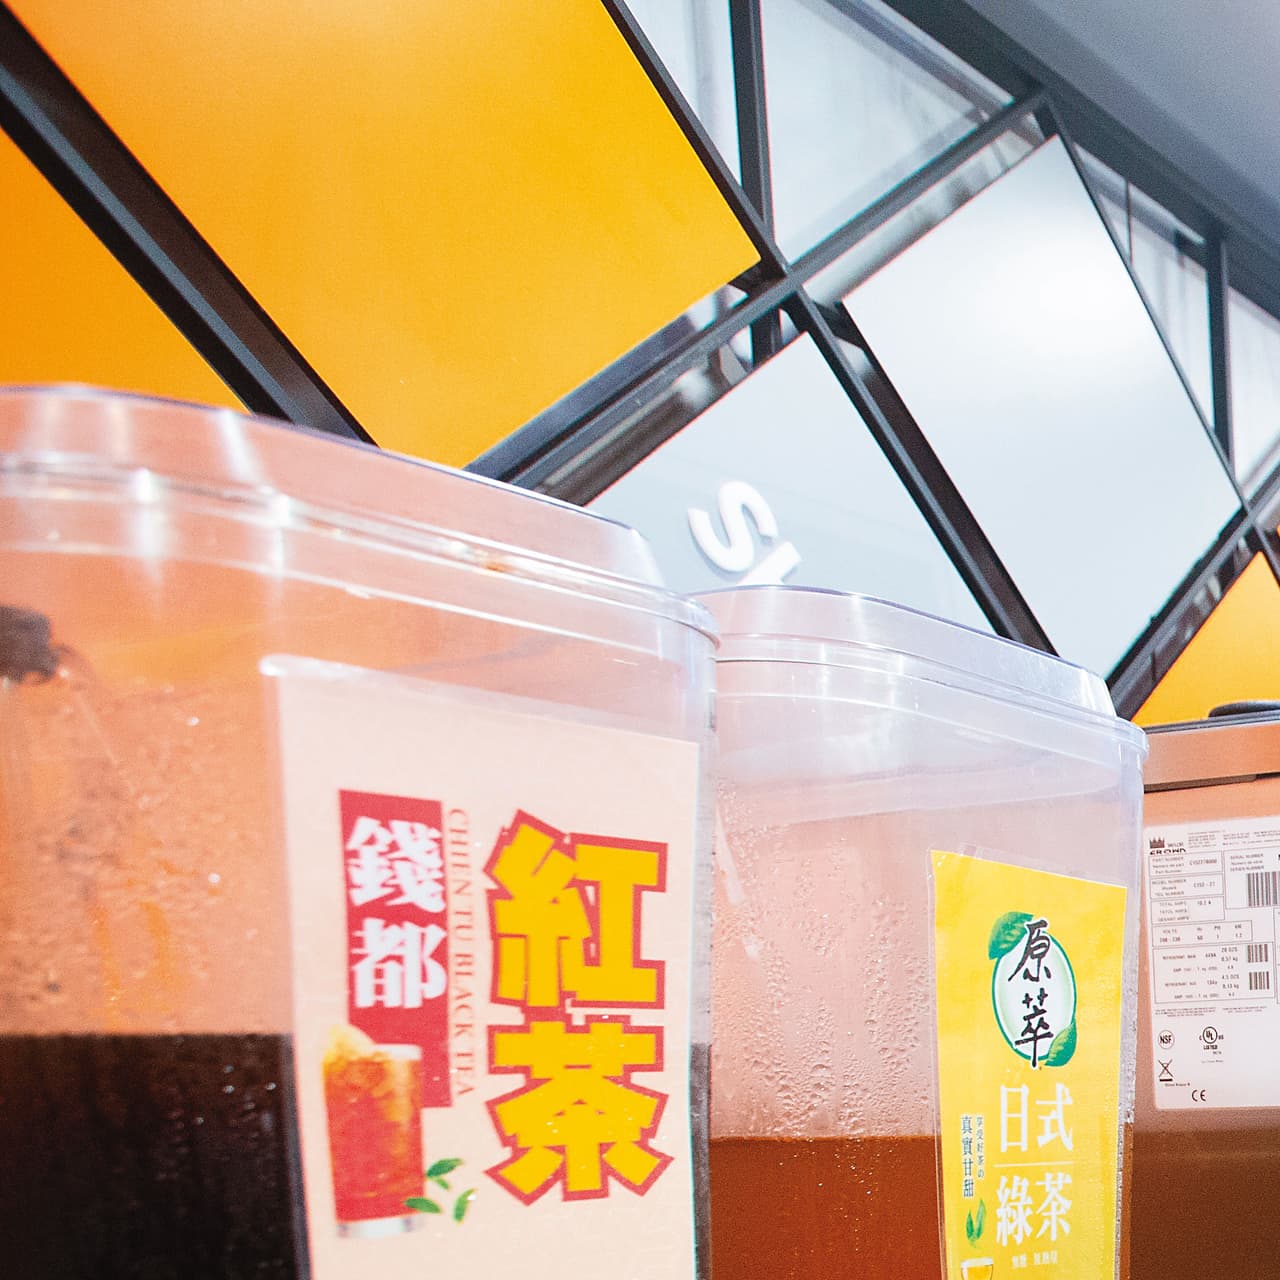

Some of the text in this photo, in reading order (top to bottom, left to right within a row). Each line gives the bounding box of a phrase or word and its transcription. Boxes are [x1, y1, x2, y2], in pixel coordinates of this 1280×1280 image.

[345, 815, 447, 1010] 錢都
[450, 808, 476, 1097] CHIEN TU BLACK TEA
[484, 808, 674, 1206] 紅茶
[1007, 918, 1054, 1068] 原萃
[1159, 1034, 1172, 1045] NSF
[1000, 1082, 1074, 1153] 日式
[1191, 1088, 1207, 1103] CE
[996, 1172, 1073, 1247] 綠茶
